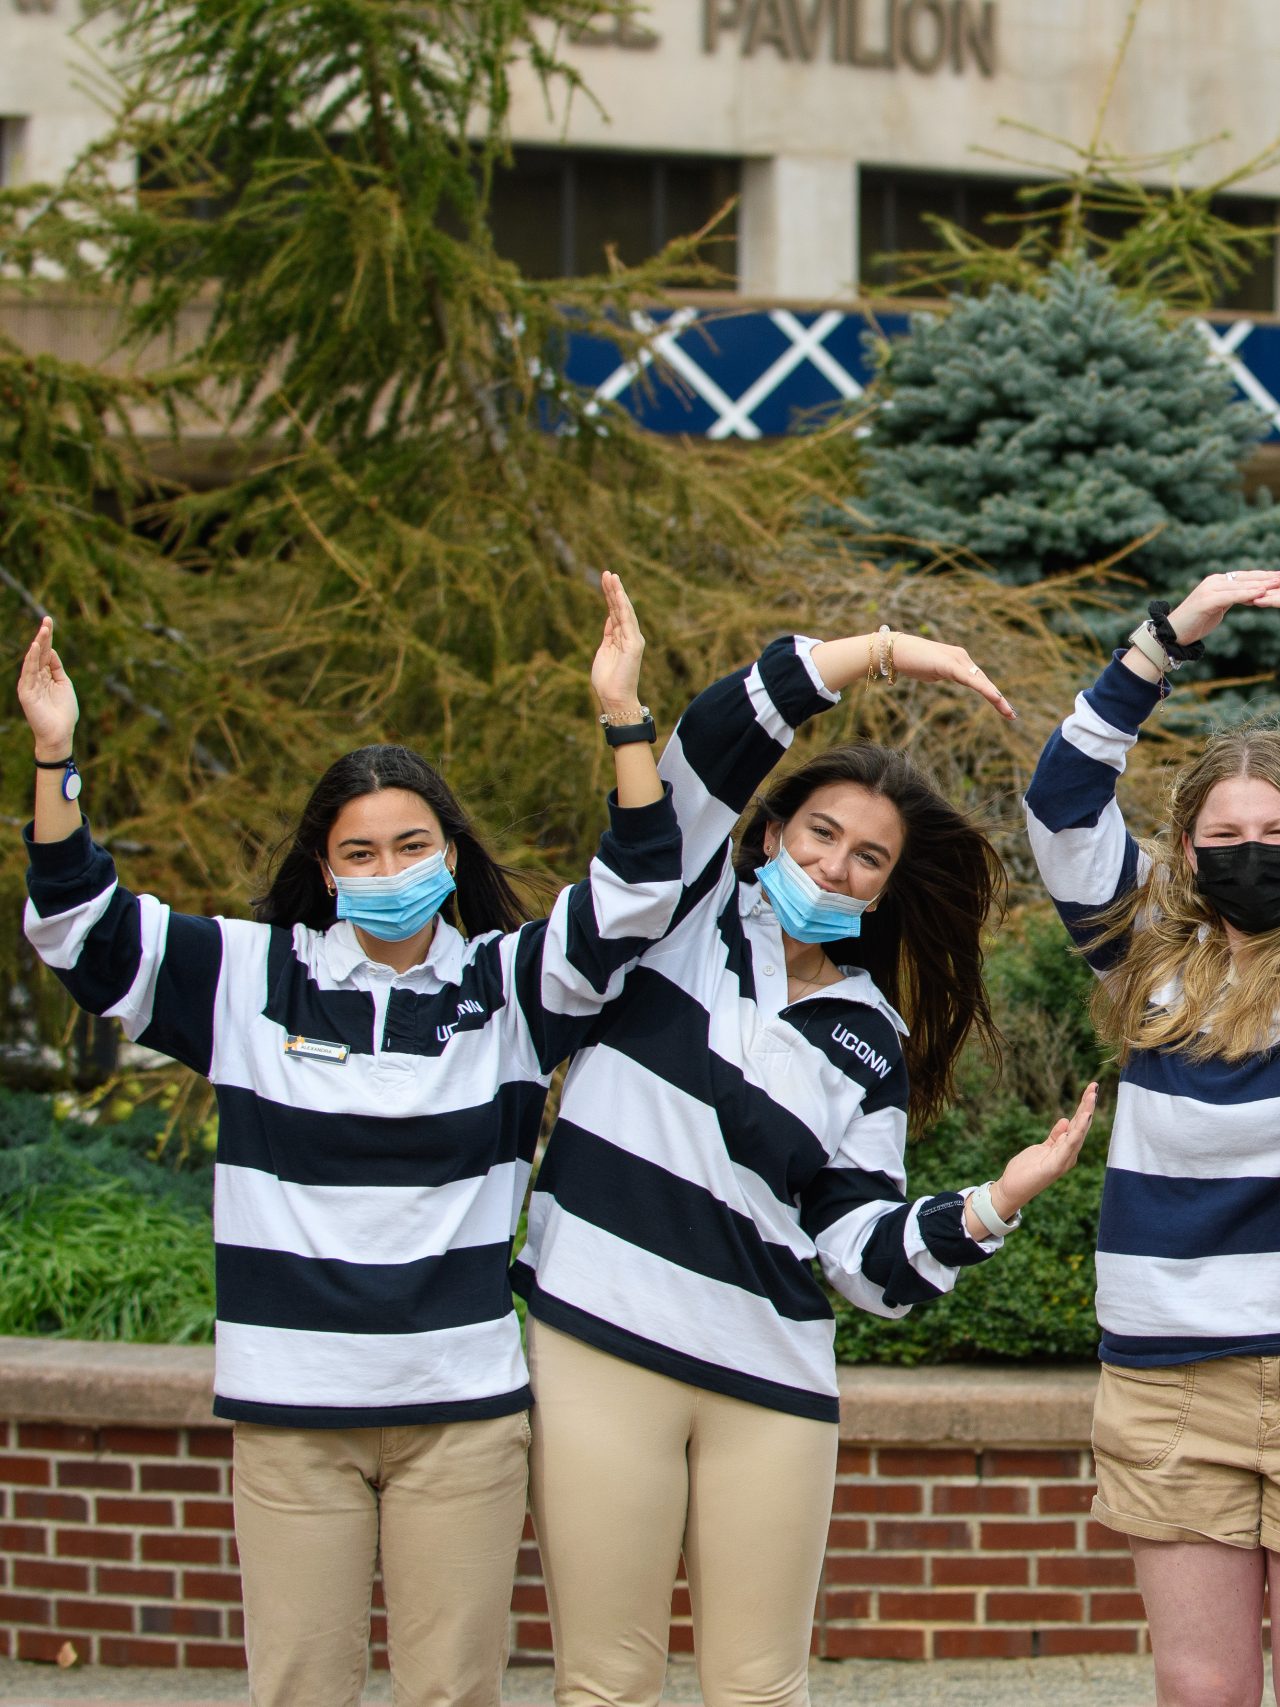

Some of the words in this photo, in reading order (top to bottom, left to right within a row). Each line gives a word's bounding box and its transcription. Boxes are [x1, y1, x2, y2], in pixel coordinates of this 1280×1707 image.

[703, 0, 997, 78] PAVILION
[436, 999, 485, 1042] UCNN
[831, 1022, 892, 1079] UCONN
